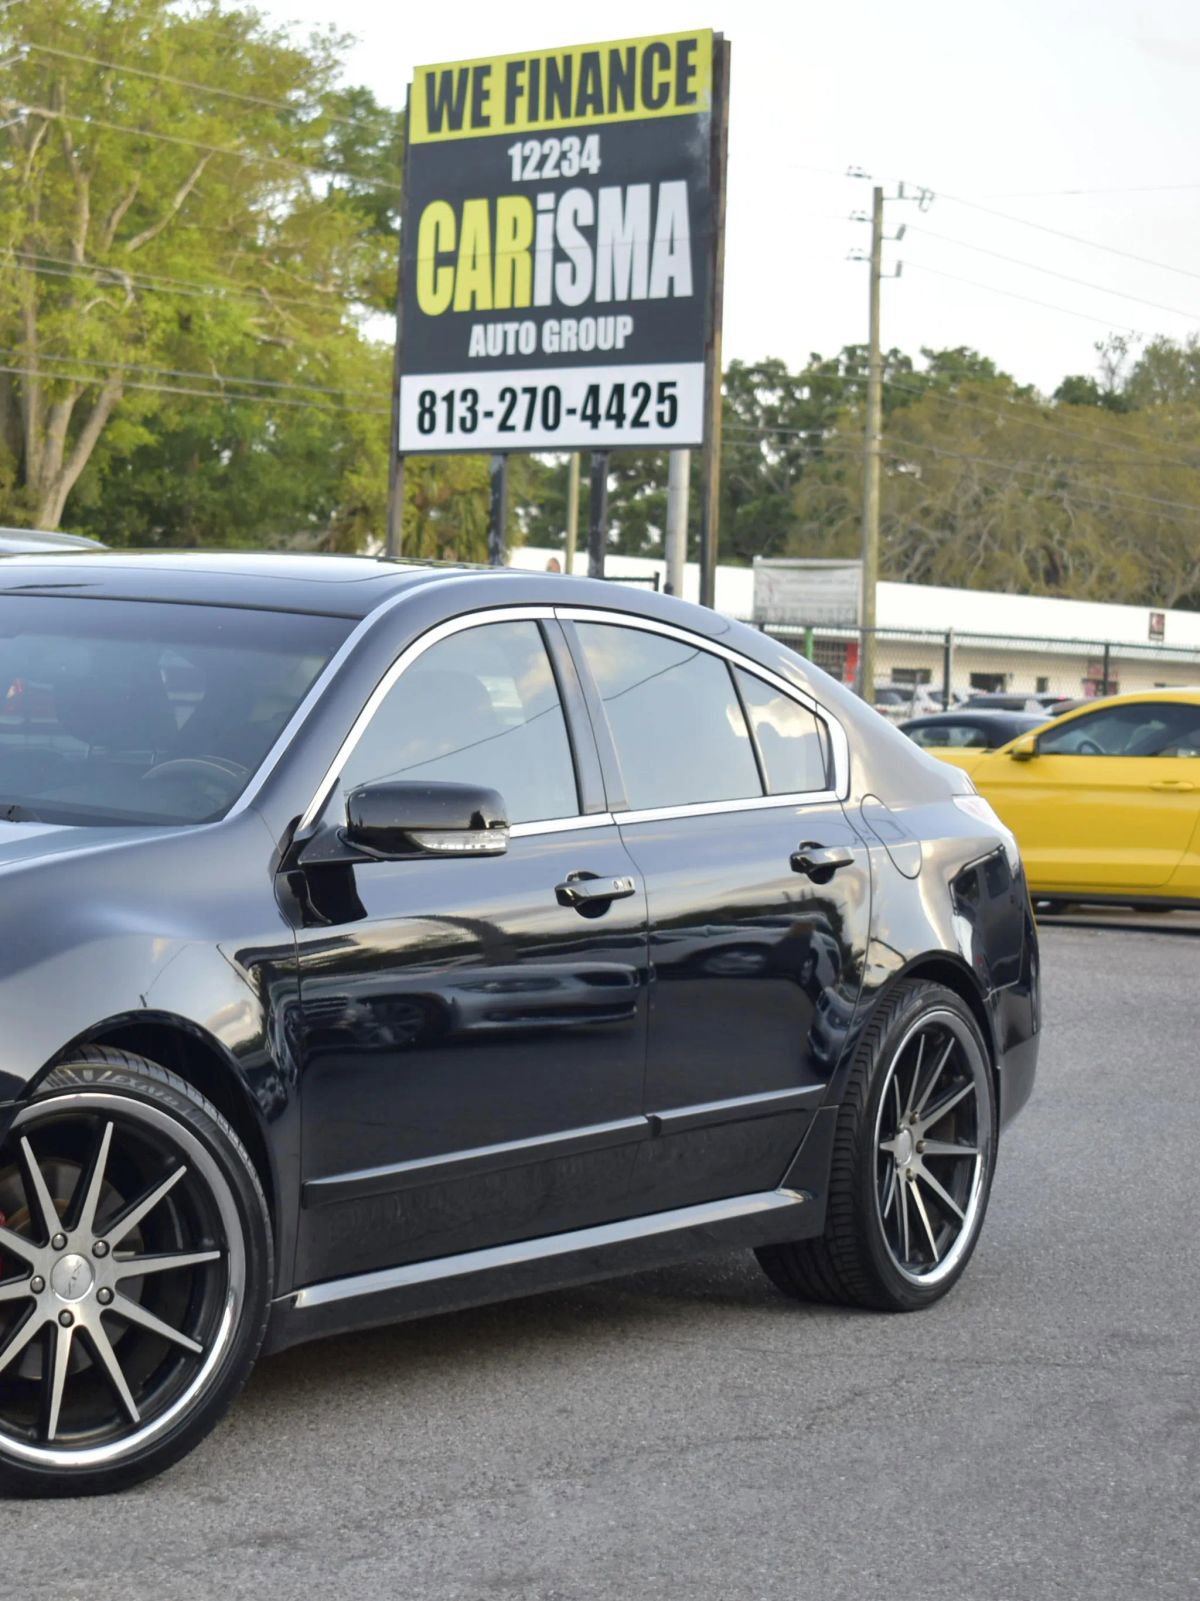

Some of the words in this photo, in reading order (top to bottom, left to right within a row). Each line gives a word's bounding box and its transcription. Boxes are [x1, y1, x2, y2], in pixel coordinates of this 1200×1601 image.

[425, 65, 492, 134] WE
[504, 38, 698, 126] FINANCE
[507, 134, 601, 182] 12234
[468, 320, 537, 357] AUTO
[542, 315, 634, 354] GROUP
[417, 381, 678, 435] 813-270-4425
